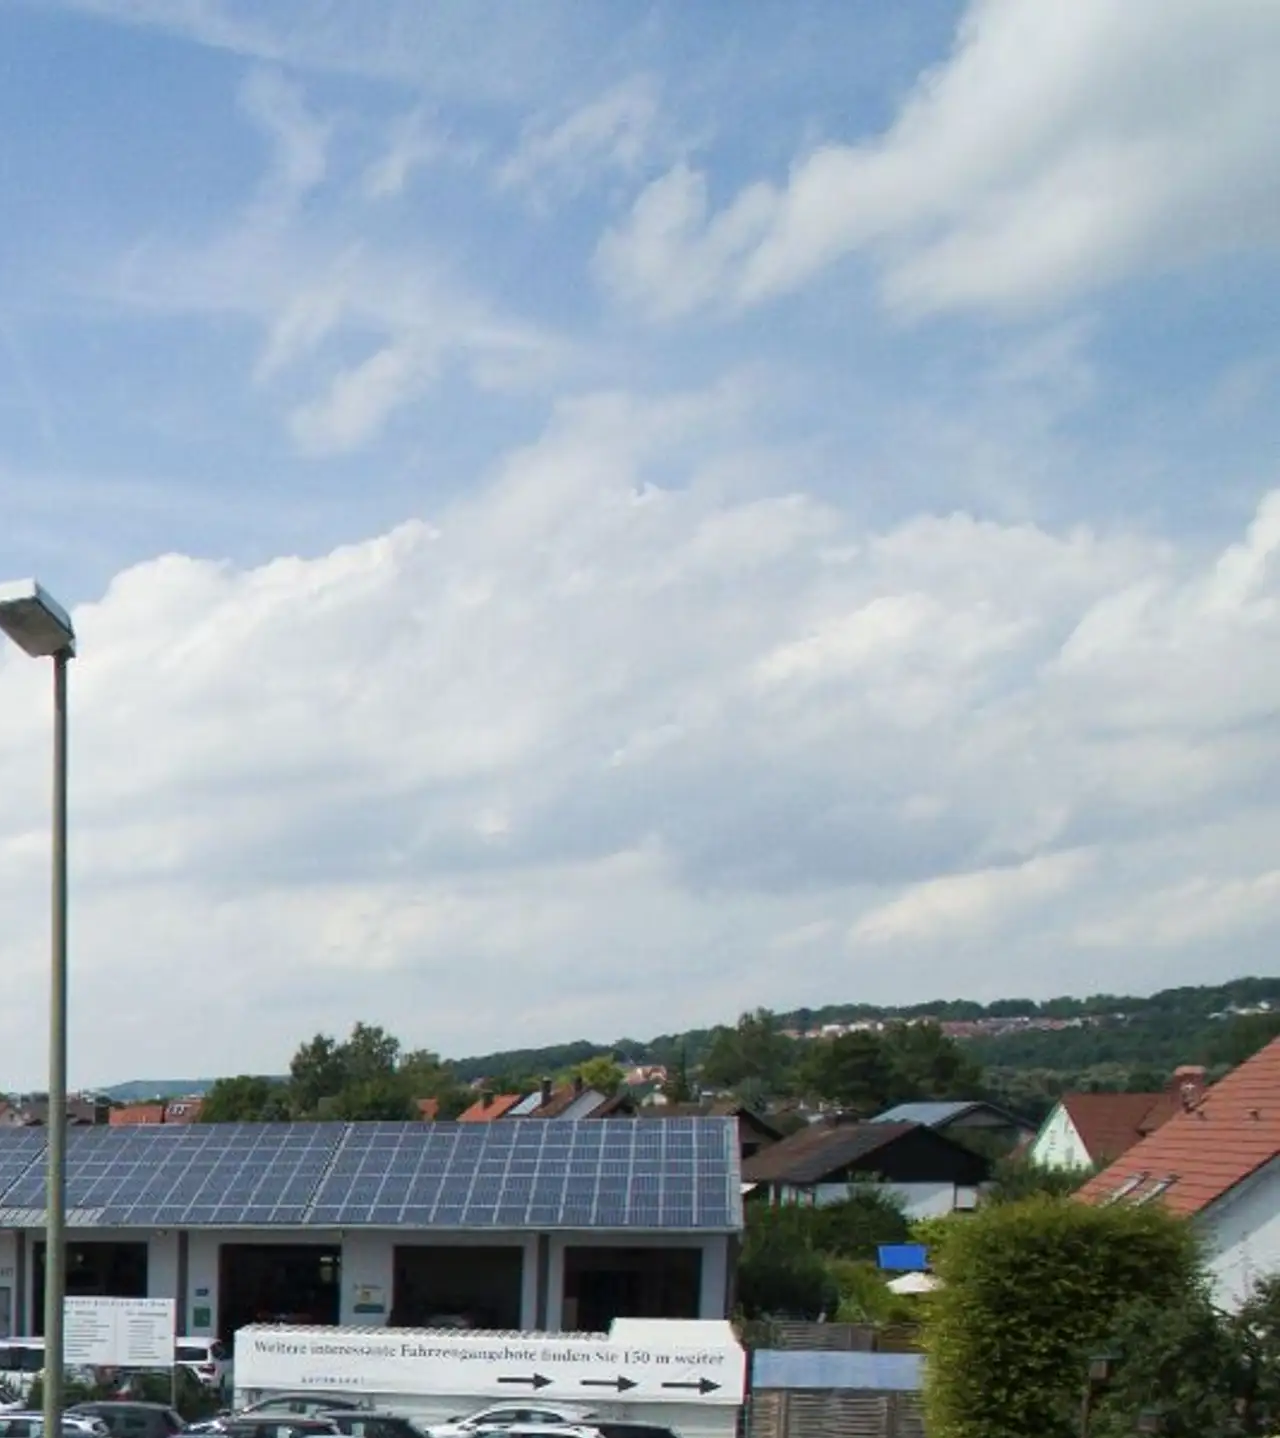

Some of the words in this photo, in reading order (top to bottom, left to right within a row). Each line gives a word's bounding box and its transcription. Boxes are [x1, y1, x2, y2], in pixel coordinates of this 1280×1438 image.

[254, 1341, 307, 1355] Weitere
[624, 1351, 650, 1365] 150
[655, 1354, 671, 1365] m
[674, 1353, 725, 1367] weiter
